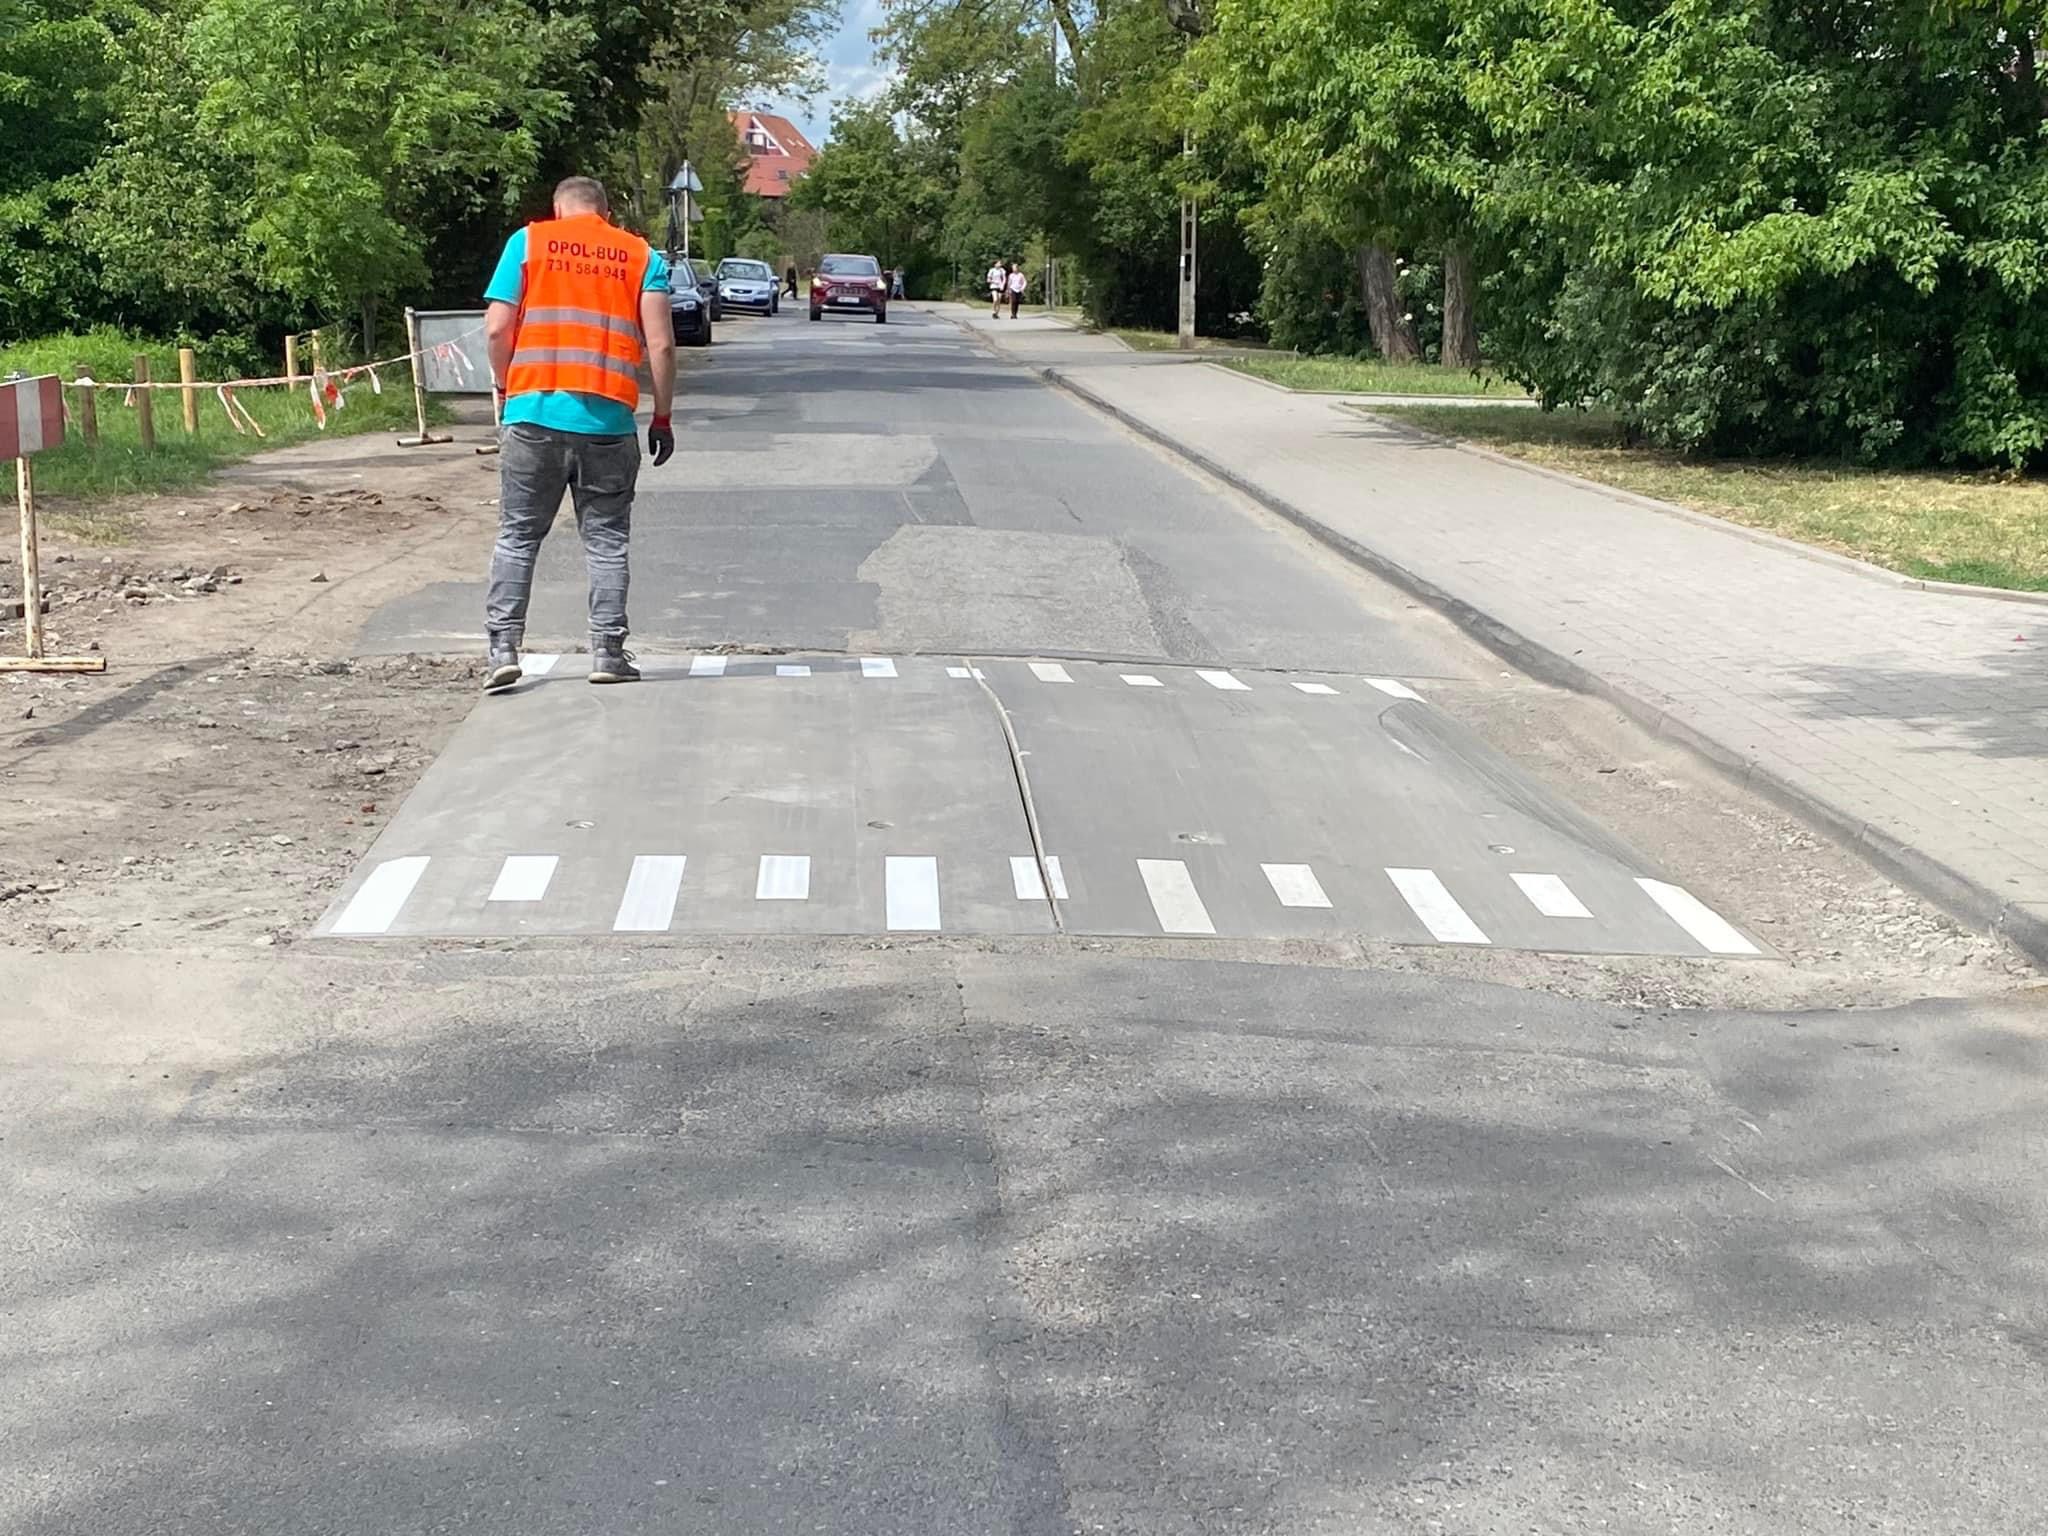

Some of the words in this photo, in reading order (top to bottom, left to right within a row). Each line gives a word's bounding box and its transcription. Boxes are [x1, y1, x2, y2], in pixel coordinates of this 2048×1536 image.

[548, 240, 628, 263] OPOL-BUD
[547, 259, 570, 272] 731
[575, 263, 599, 275] 584
